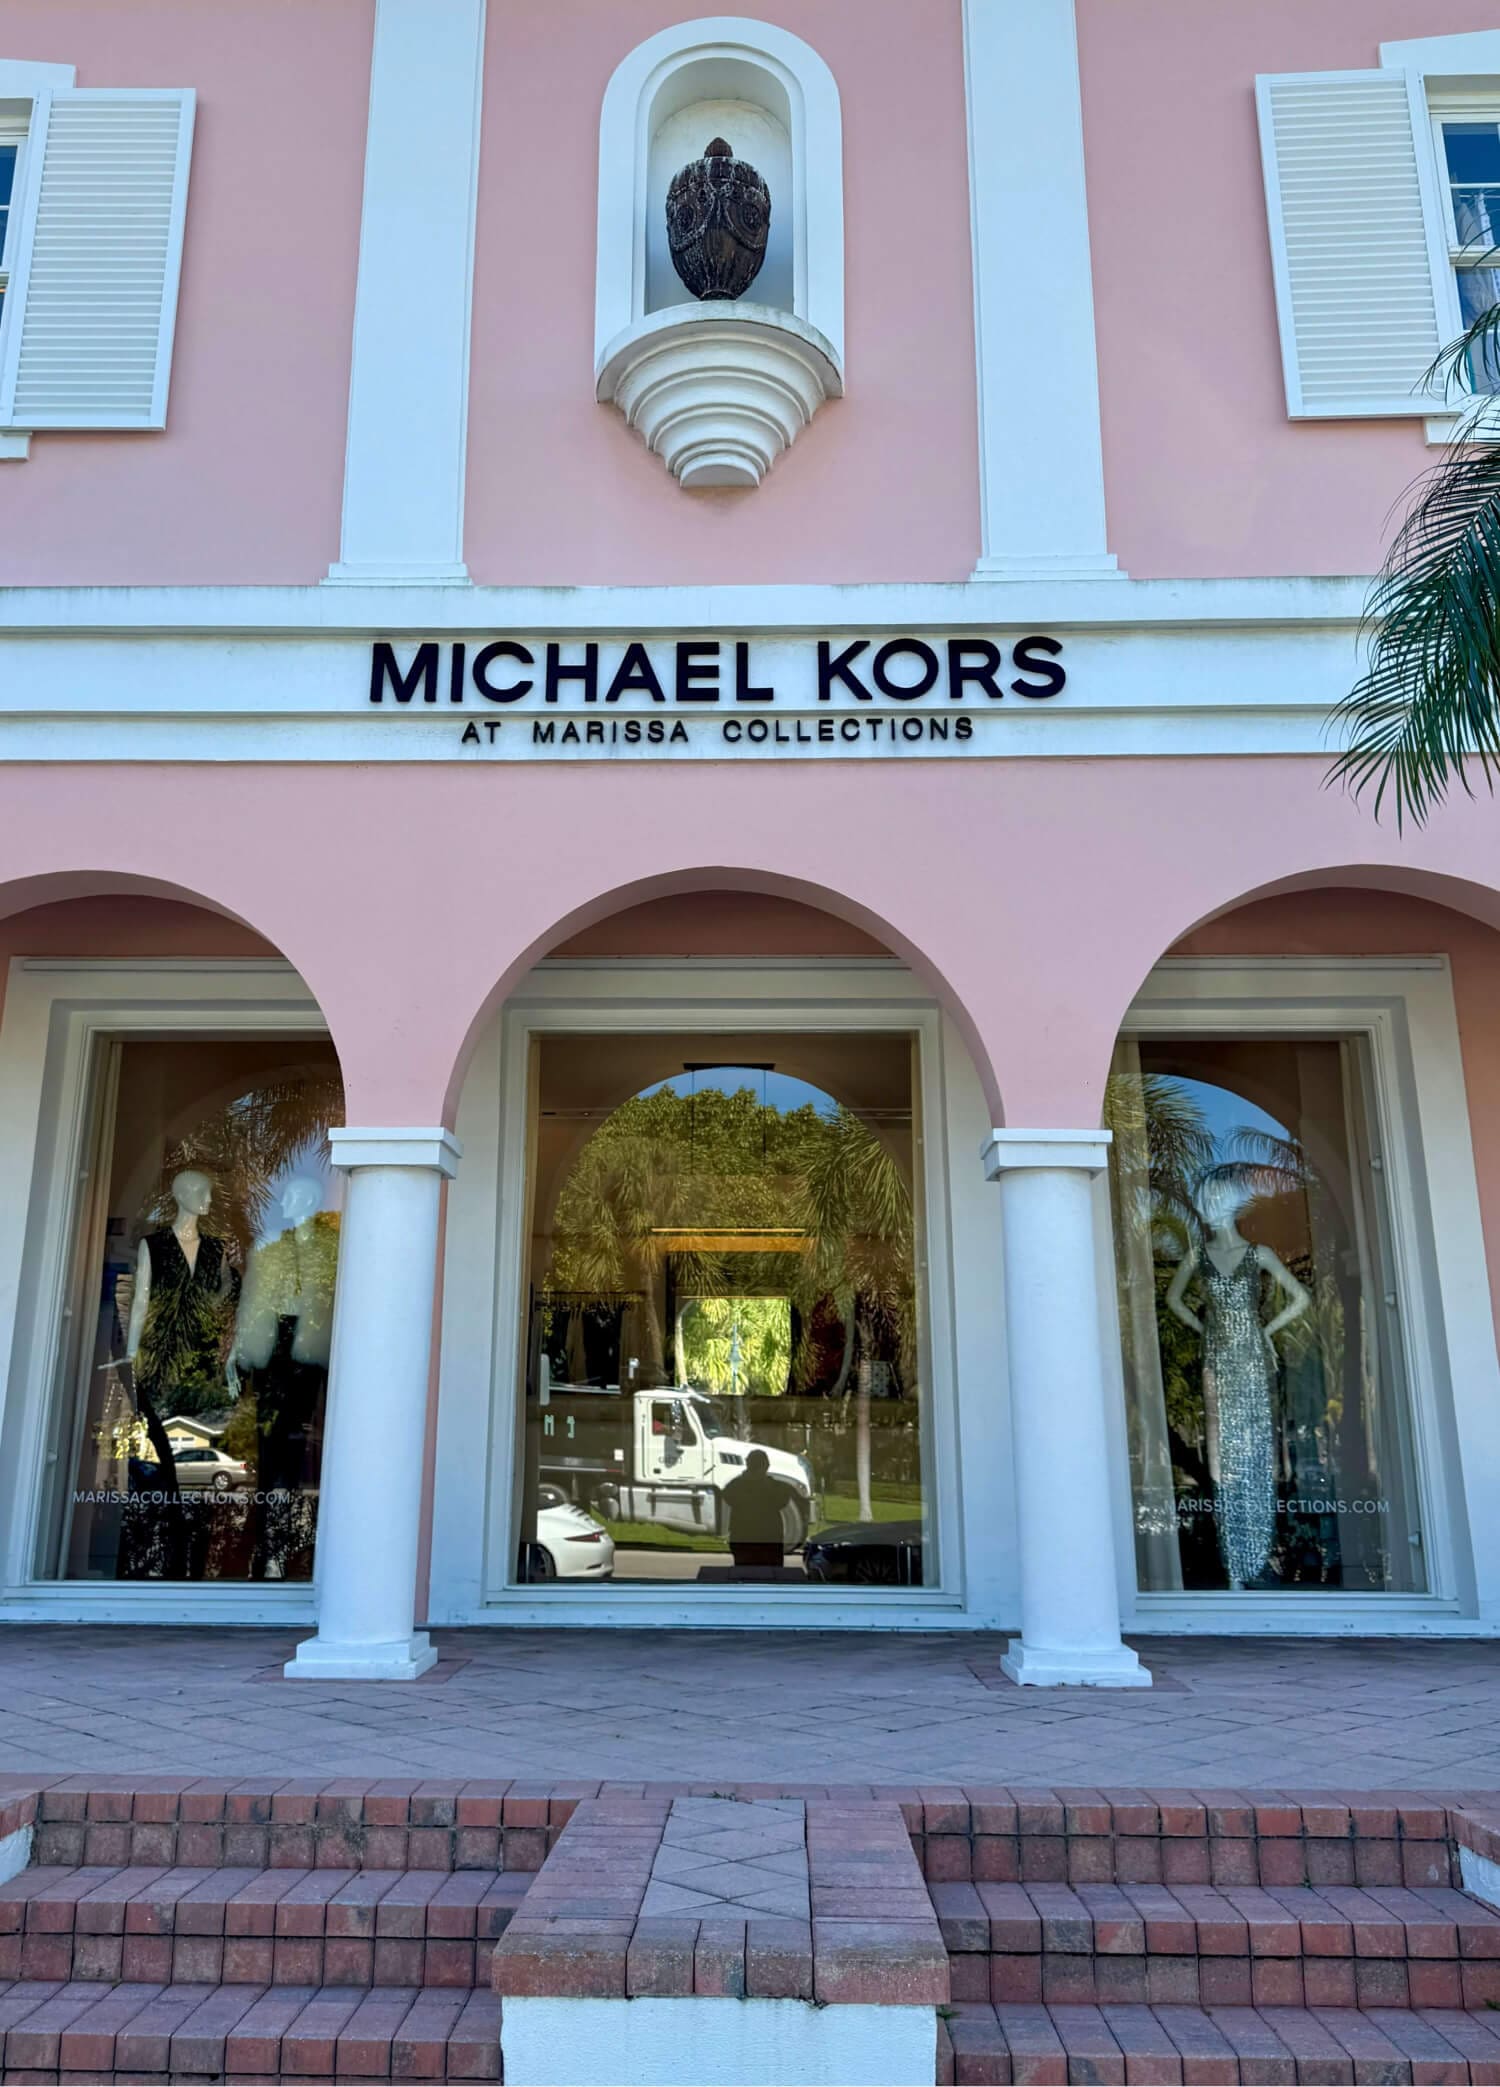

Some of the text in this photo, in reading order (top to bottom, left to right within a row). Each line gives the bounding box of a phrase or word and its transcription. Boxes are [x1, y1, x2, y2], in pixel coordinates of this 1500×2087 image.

[369, 635, 1066, 703] MICHAEL KORS
[461, 716, 974, 745] AT MARISSA COLLECTIONS
[72, 1490, 290, 1505] MARISSACOLLECTIONS.COM
